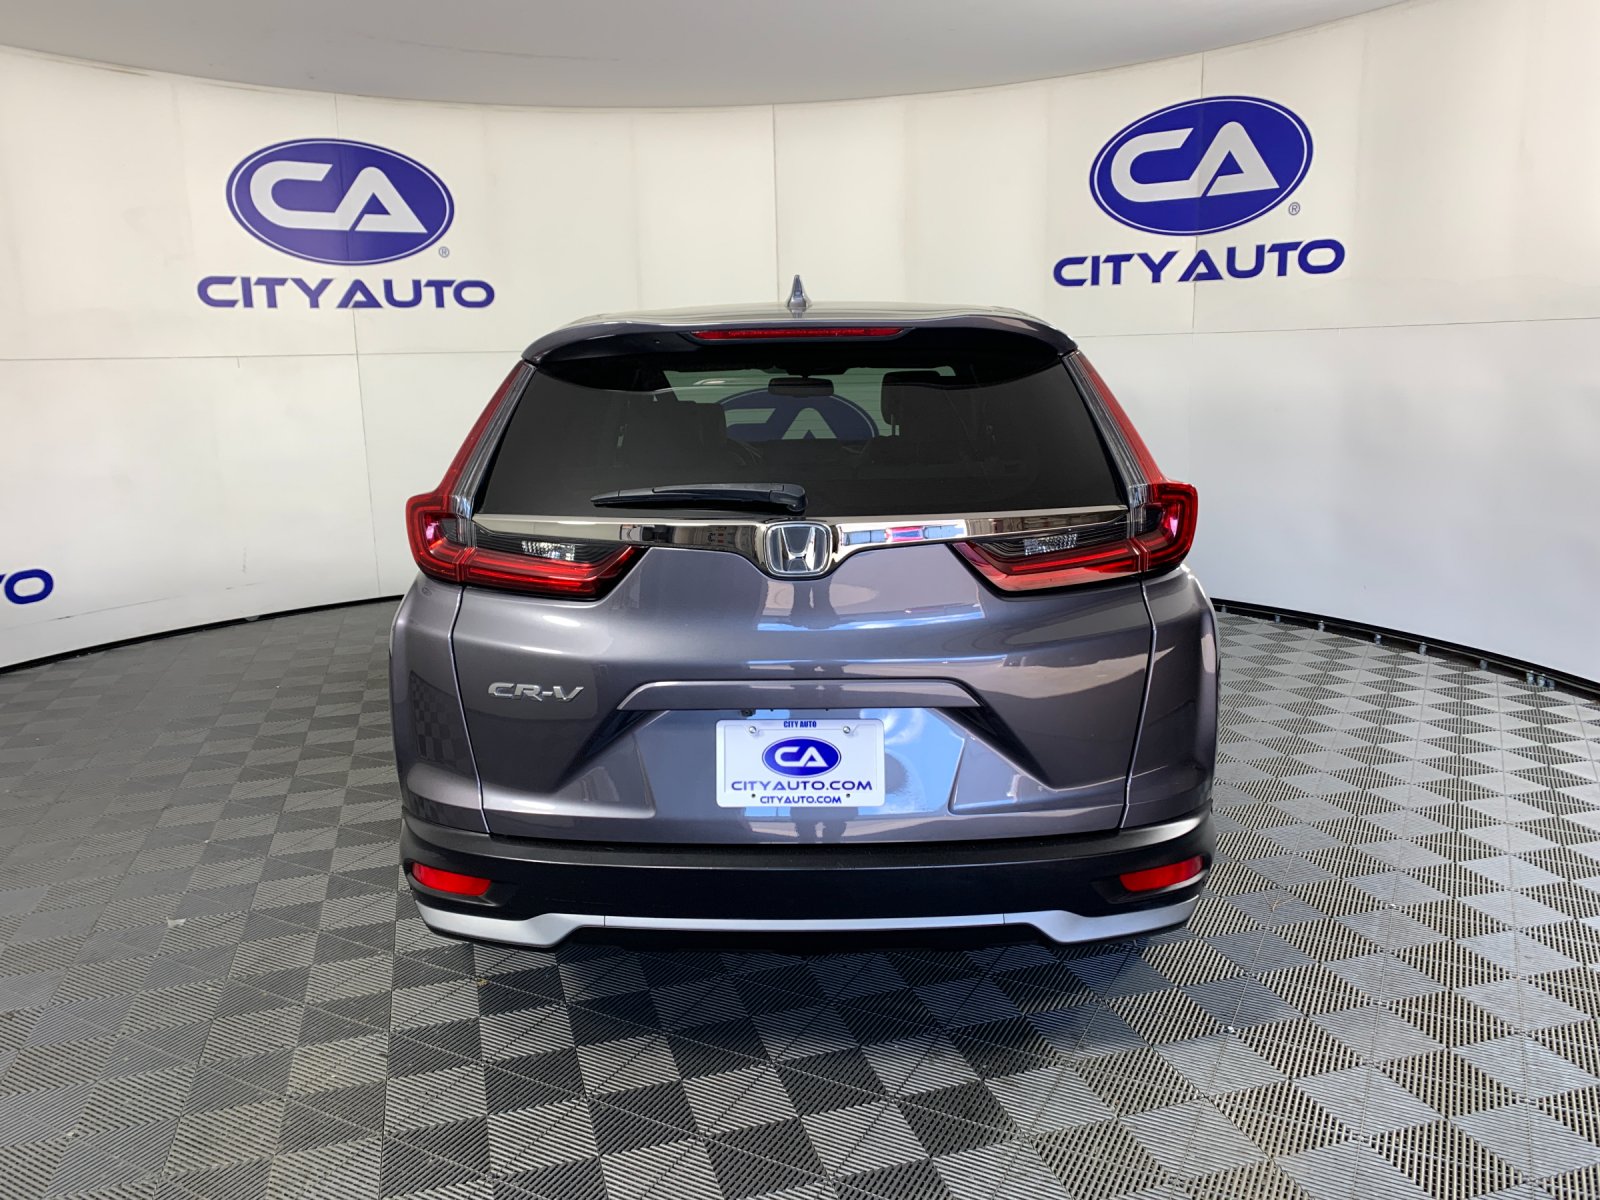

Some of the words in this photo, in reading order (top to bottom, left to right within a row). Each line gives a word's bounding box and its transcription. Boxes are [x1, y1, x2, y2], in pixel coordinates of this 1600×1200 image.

[1110, 120, 1281, 203] CA
[249, 159, 429, 234] CA
[1053, 249, 1181, 287] CITY
[1177, 238, 1346, 283] AUTO
[196, 275, 335, 309] CITY
[336, 278, 496, 309] AUTO
[0, 568, 54, 605] O
[488, 682, 585, 702] CR-V
[783, 720, 799, 728] CITY
[799, 720, 817, 728] AUTO
[774, 746, 830, 768] CA
[731, 780, 873, 791] CITYAUTO.COM
[760, 795, 842, 804] CITYAUTO.COM
